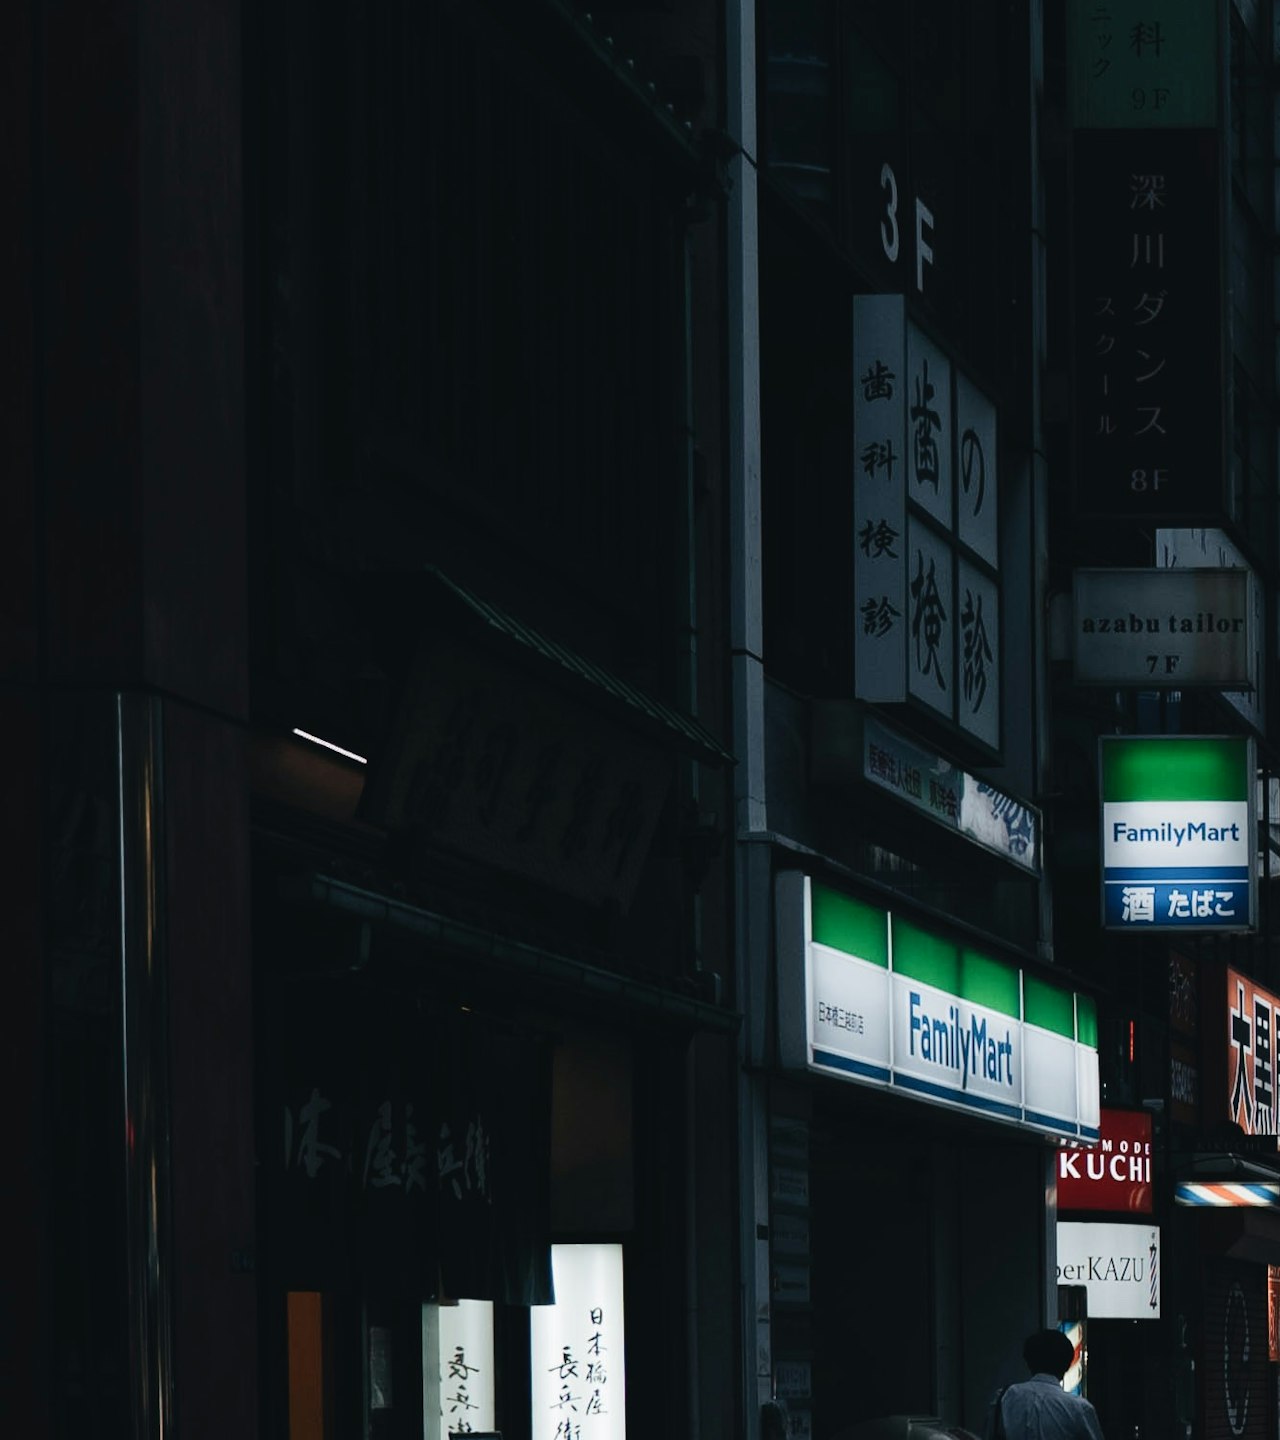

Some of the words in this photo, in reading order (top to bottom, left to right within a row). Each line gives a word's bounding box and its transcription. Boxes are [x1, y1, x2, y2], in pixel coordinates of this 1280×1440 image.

[1131, 88, 1171, 111] 9F
[879, 162, 935, 292] 3F
[1128, 173, 1168, 438] 深川ダンス
[1095, 296, 1116, 436] スクール
[910, 360, 986, 517] 歯の
[1130, 468, 1170, 493] 8F
[858, 360, 902, 637] 歯科検診
[910, 548, 993, 714] 検診
[1082, 612, 1161, 634] azabu
[1168, 613, 1244, 634] tailor
[1146, 655, 1180, 674] 7F
[1113, 820, 1240, 847] FamilyMart
[1121, 886, 1155, 922] 酒
[1168, 888, 1237, 918] たばこ
[908, 990, 1013, 1090] FamilyMart
[585, 1306, 609, 1416] 日本橋屋
